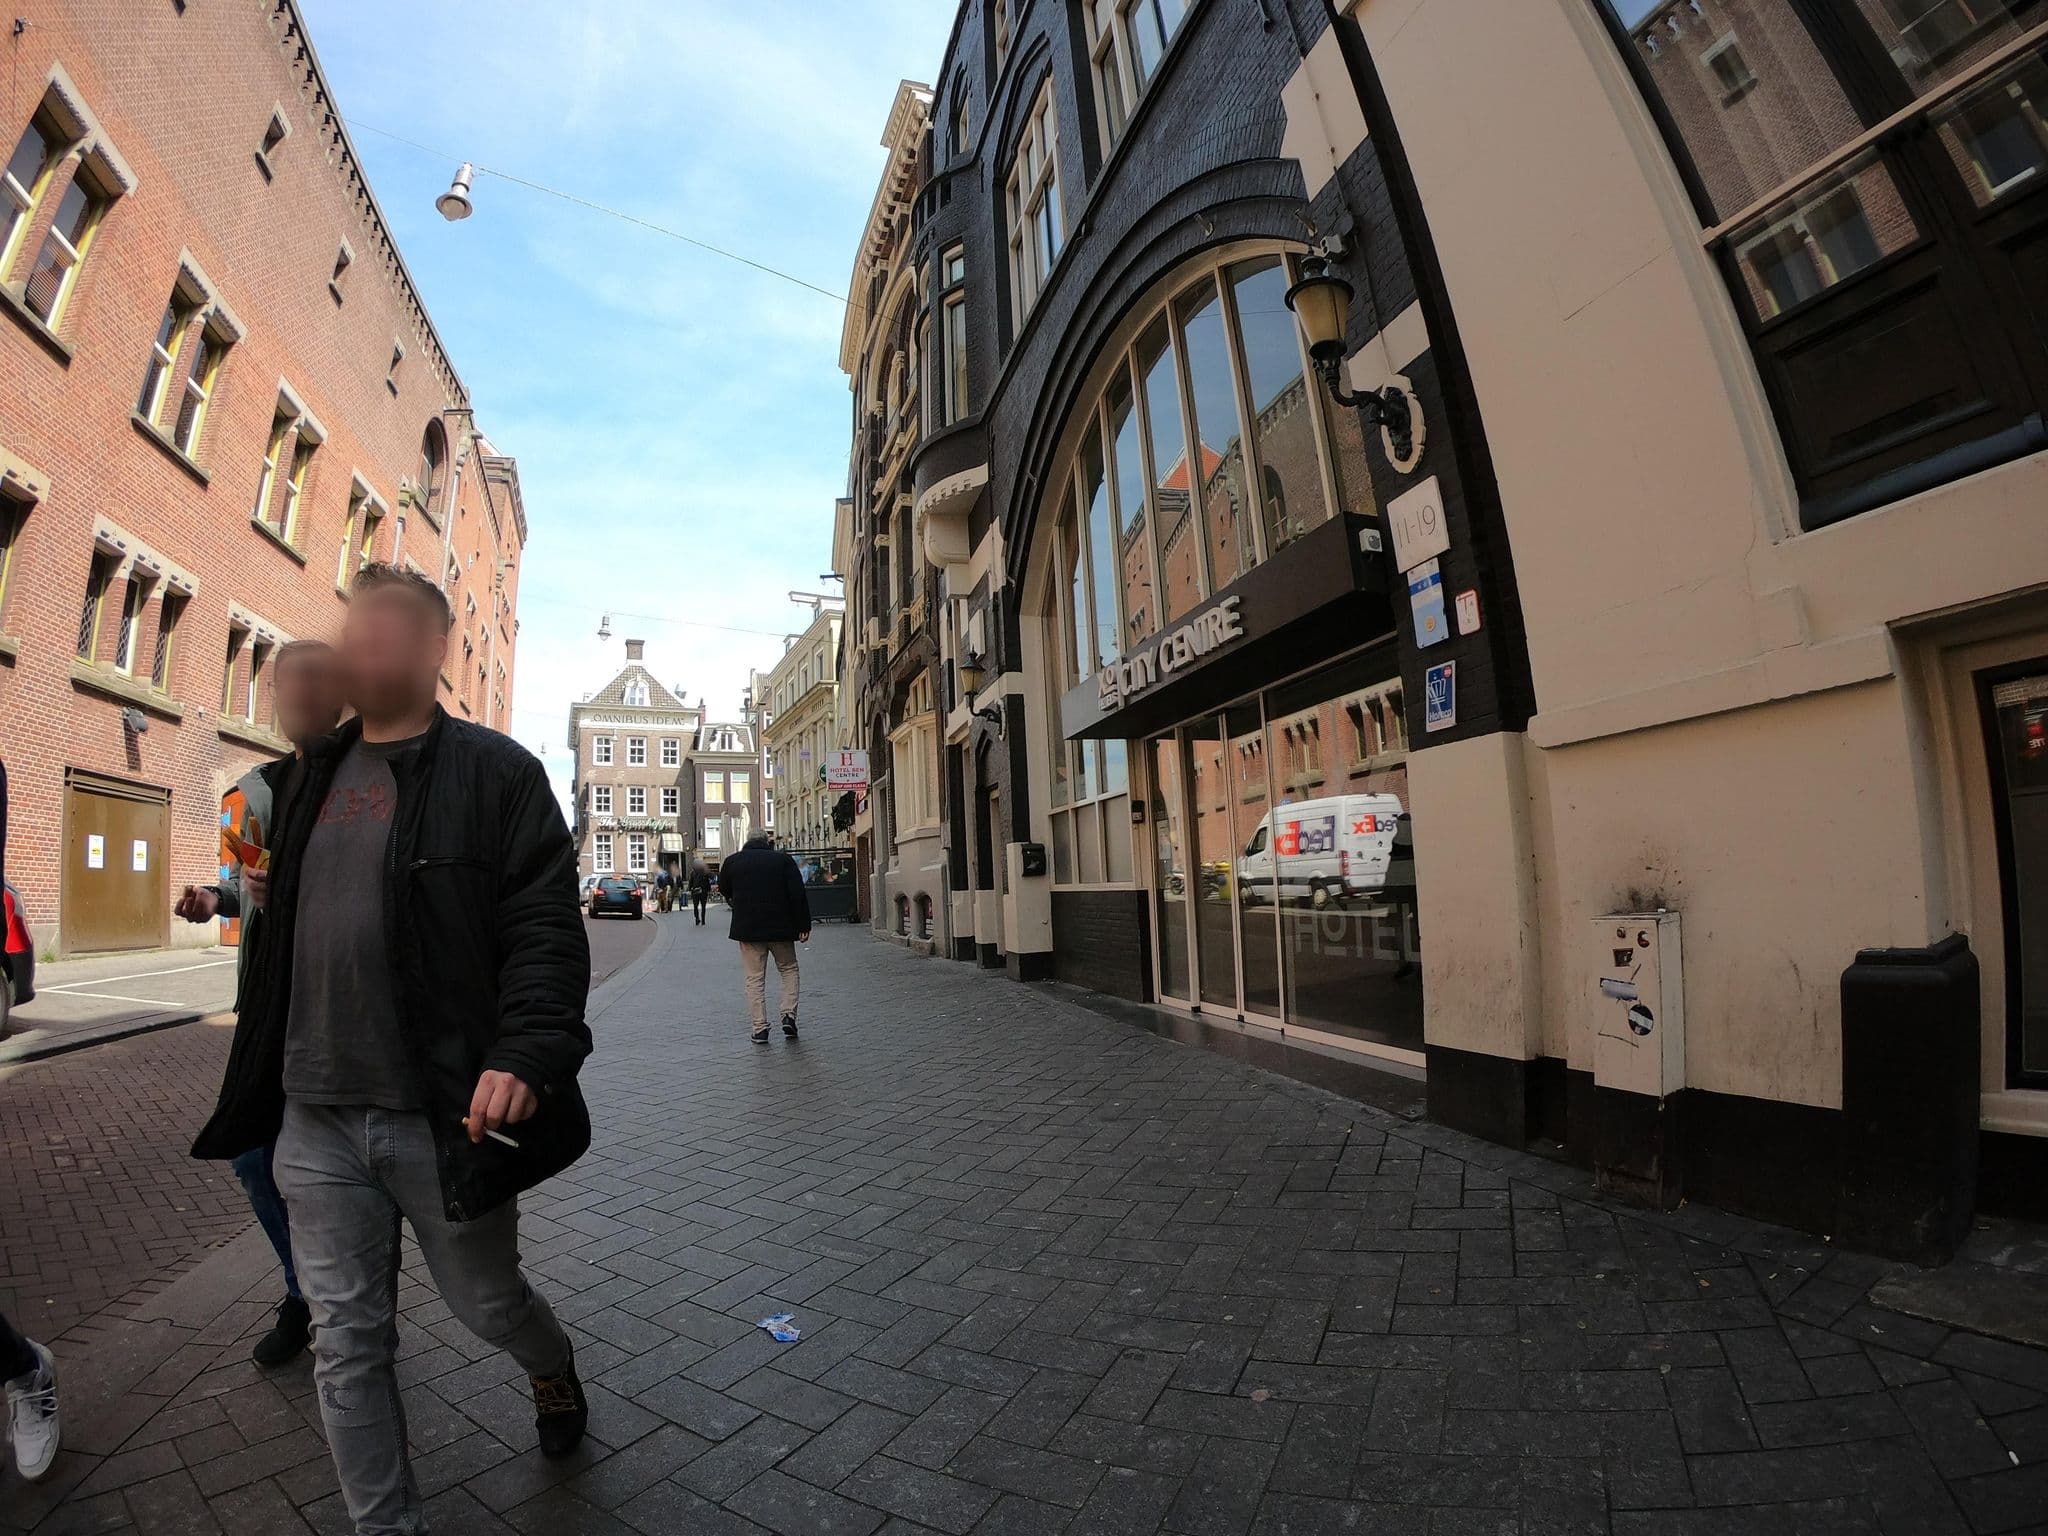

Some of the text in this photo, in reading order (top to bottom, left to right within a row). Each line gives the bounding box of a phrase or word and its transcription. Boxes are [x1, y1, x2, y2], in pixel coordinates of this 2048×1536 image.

[1396, 504, 1437, 549] 11-19
[1119, 646, 1158, 697] CITY
[1159, 595, 1244, 673] CENTRE
[593, 713, 649, 725] OMNIBUS
[1294, 902, 1422, 963] HOTEL
